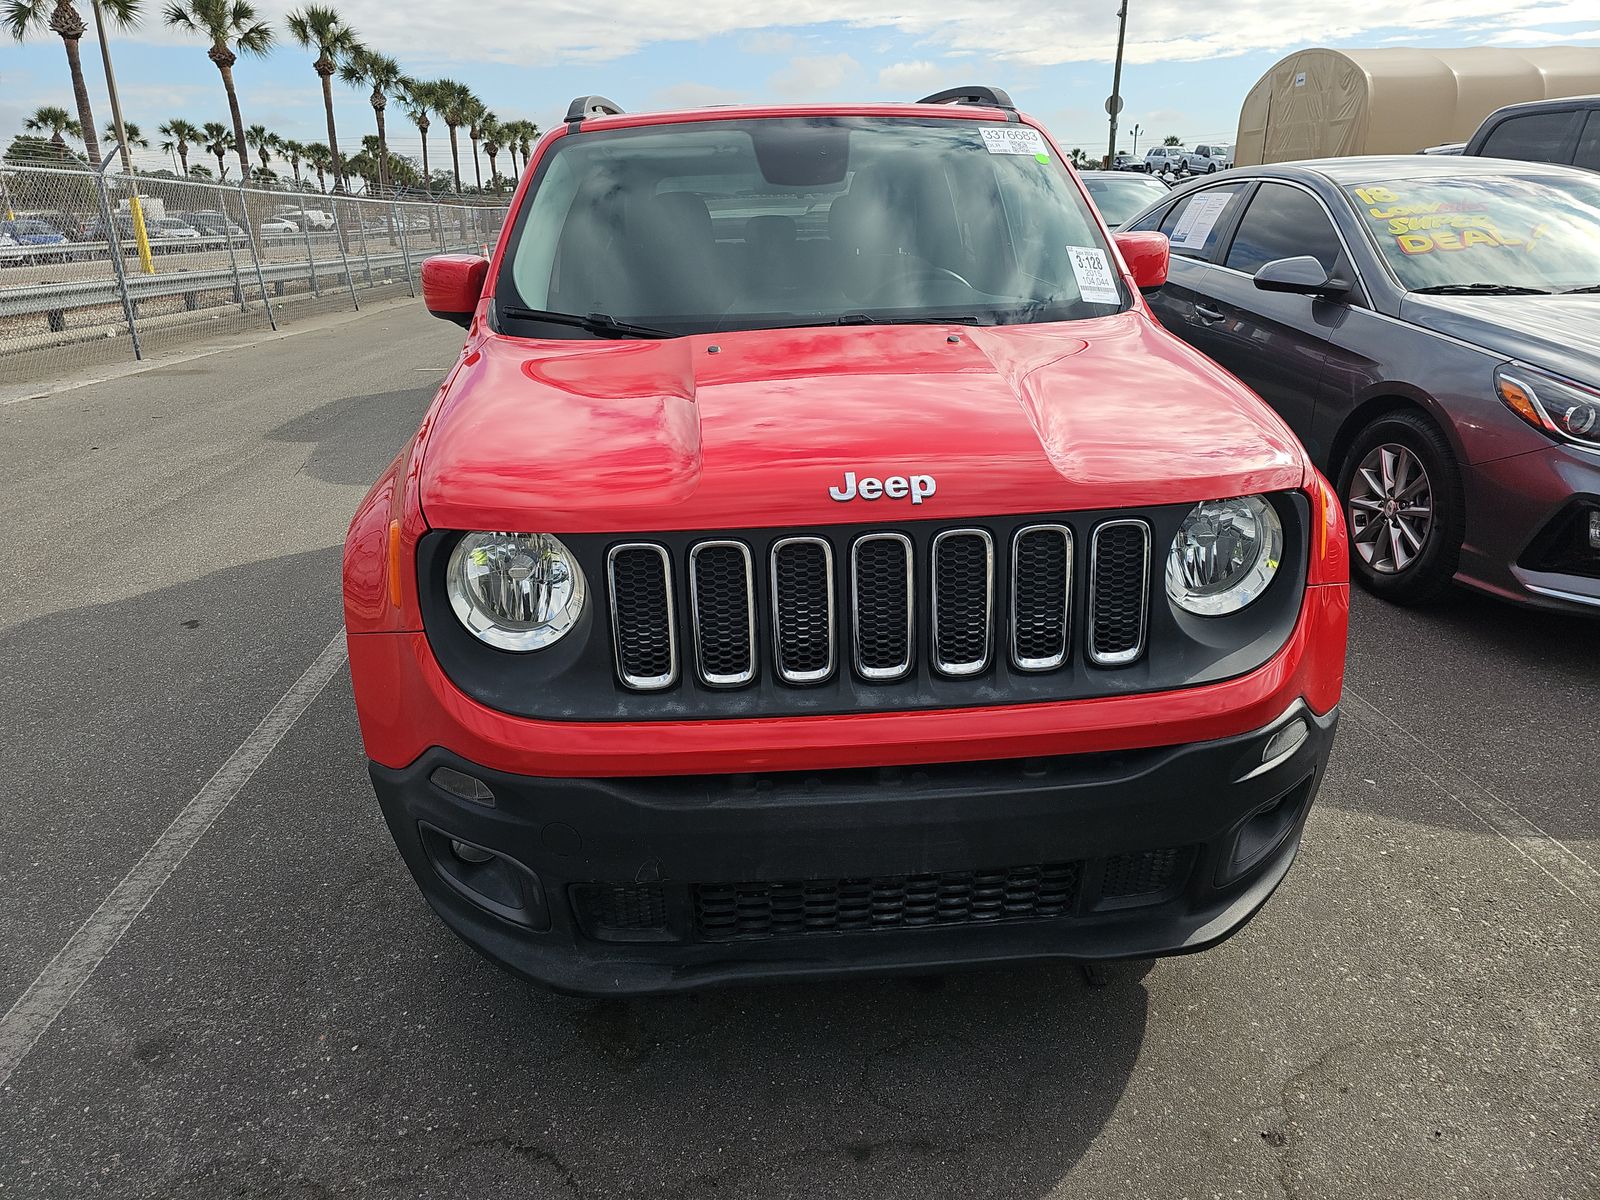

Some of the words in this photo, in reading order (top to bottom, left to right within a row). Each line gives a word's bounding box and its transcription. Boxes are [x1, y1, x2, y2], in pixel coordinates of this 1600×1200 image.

[983, 129, 1038, 142] 3376683
[1076, 255, 1103, 270] 3:128
[1085, 269, 1103, 278] 2015
[829, 471, 937, 505] Jeep
